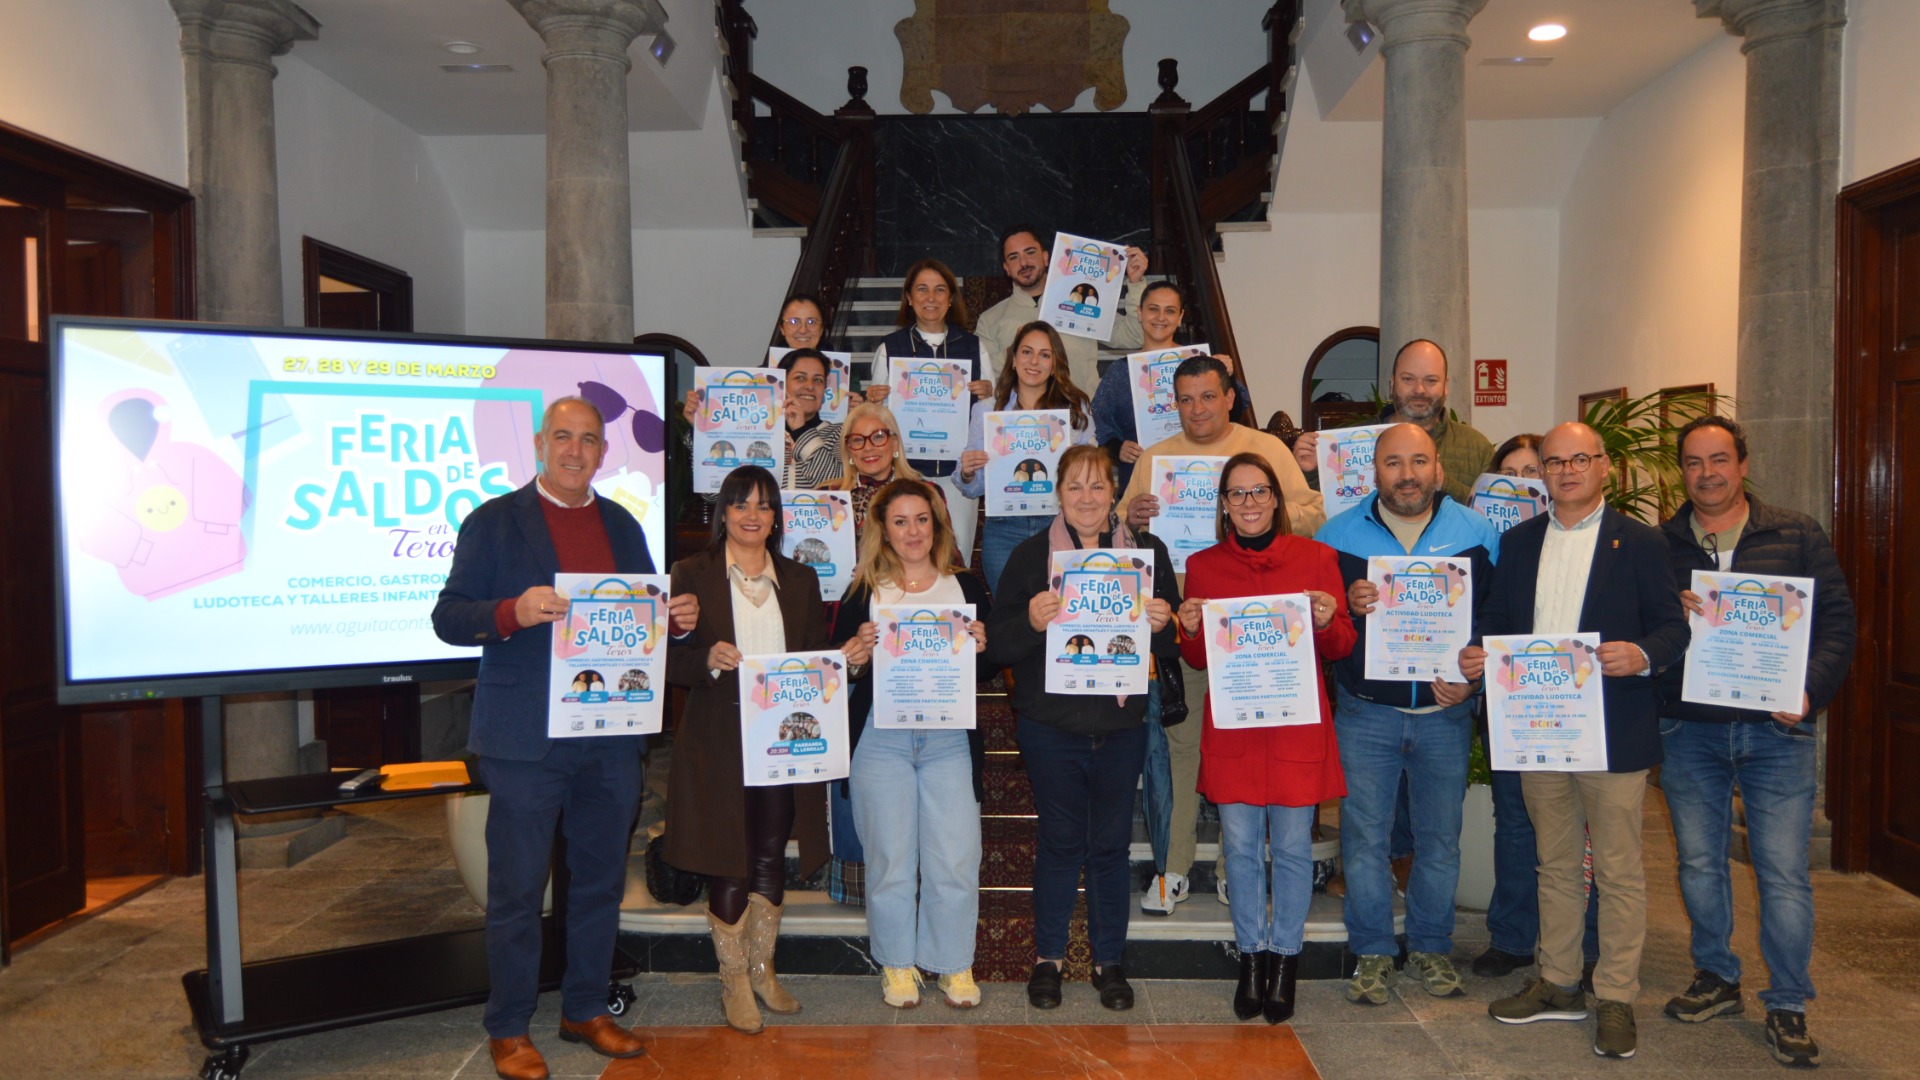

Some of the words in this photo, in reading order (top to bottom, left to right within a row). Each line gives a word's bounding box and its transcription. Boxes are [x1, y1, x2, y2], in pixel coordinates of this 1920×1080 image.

[1080, 256, 1100, 265] FERIA
[1072, 265, 1104, 278] SALDOS
[283, 357, 314, 374] 27,
[317, 358, 344, 373] 28
[349, 359, 363, 374] Y
[366, 360, 392, 375] 29
[395, 361, 423, 376] DE
[426, 362, 496, 379] MARZO
[920, 377, 941, 385] FERIA
[1156, 376, 1174, 386] SAL
[913, 386, 948, 397] SALDOS
[722, 393, 757, 406] FERIA
[1476, 395, 1506, 403] EXTINTOR
[712, 407, 768, 424] SALDOS
[331, 414, 472, 466] FERIA
[1016, 430, 1039, 439] FERIA
[1010, 439, 1046, 451] SALDOS
[1345, 454, 1375, 468] SALD
[446, 462, 475, 483] DE
[1186, 478, 1212, 487] FERIA
[286, 466, 514, 534] SALDOS
[794, 508, 819, 517] FERIA
[1486, 504, 1519, 518] FERIA
[428, 523, 449, 536] en
[788, 517, 828, 529] SALDOS
[388, 528, 455, 558] Tero
[287, 576, 377, 588] COMERCIO,
[1081, 580, 1120, 595] FERIA
[1407, 580, 1434, 590] FERIA
[194, 595, 284, 610] LUDOTECA
[287, 595, 297, 605] Y
[301, 592, 379, 606] TALLERES
[382, 590, 439, 602] INFANT
[1398, 590, 1443, 604] SALDOS
[1734, 598, 1767, 609] FERIA
[1068, 595, 1133, 615] SALDOS
[590, 609, 634, 625] FERIA
[1724, 610, 1776, 626] SALDOS
[290, 616, 434, 637] www.aguitaconte
[911, 627, 939, 638] FERIA
[1244, 620, 1273, 632] FERIA
[575, 625, 647, 647] SALDOS
[1237, 630, 1283, 646] SALDOS
[1740, 631, 1777, 640] COMERCIAL
[904, 638, 947, 652] SALDOS
[1527, 660, 1558, 671] FERIA
[383, 674, 413, 683] traulux
[780, 677, 809, 689] FERIA
[1519, 671, 1569, 686] SALDOS
[772, 687, 819, 703] SALDOS
